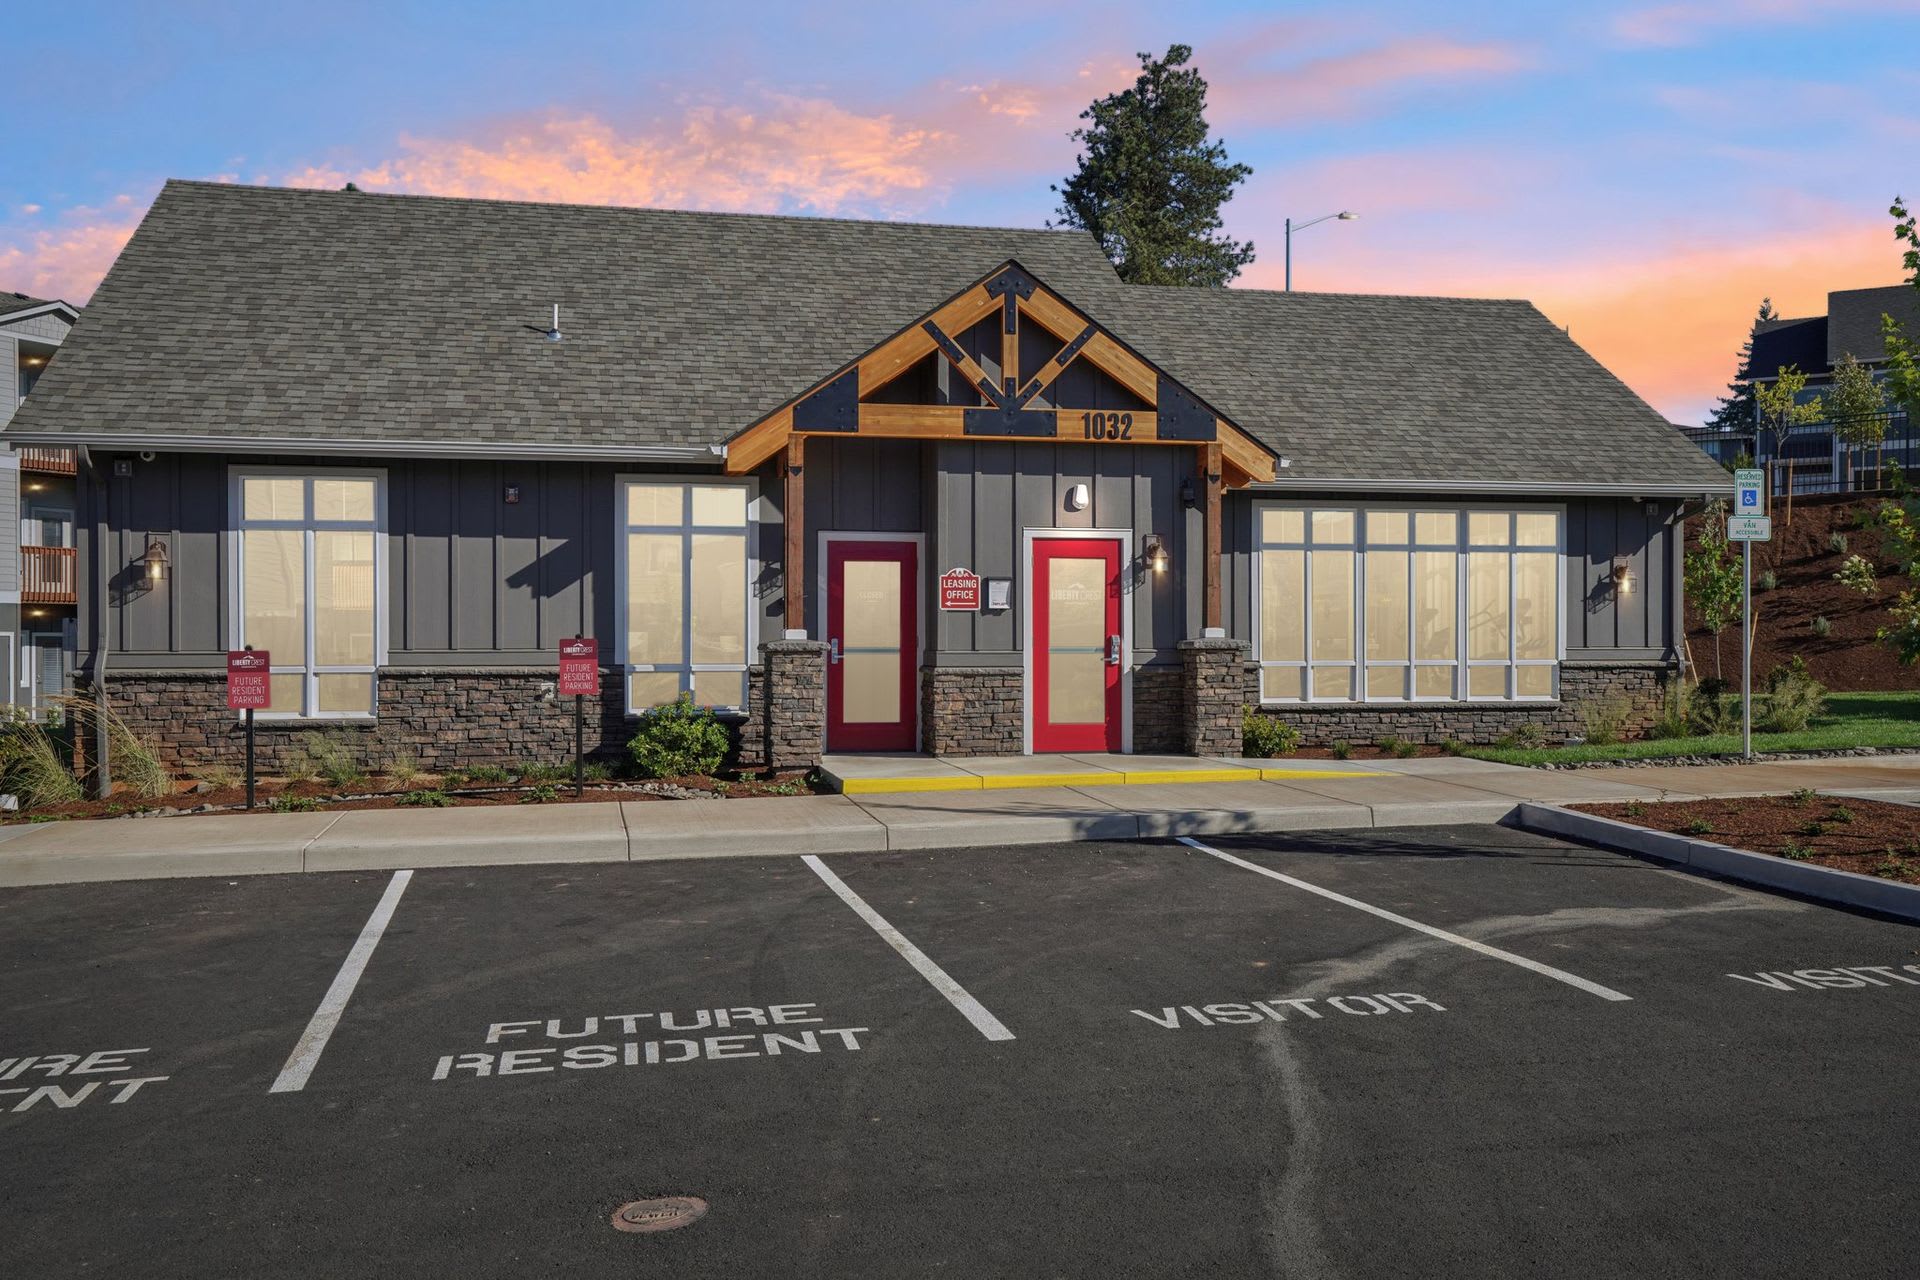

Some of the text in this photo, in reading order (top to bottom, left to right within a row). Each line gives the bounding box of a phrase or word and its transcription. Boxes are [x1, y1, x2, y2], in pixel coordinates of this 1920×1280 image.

[1081, 412, 1133, 440] 1032
[1737, 472, 1762, 480] RESERVED
[943, 579, 977, 588] LEASING
[946, 590, 974, 599] OFFICE
[251, 658, 265, 666] CREST
[566, 663, 591, 672] FUTURE
[234, 676, 263, 686] FUTURE
[563, 672, 593, 681] RESIDENT
[565, 681, 593, 690] PARKING
[231, 686, 265, 695] RESIDENT
[233, 695, 265, 704] PARKING
[1725, 965, 1920, 990] VISIT
[1130, 993, 1447, 1029] VISITOR
[485, 1003, 823, 1043] FUTURE
[432, 1027, 868, 1080] RESIDENT
